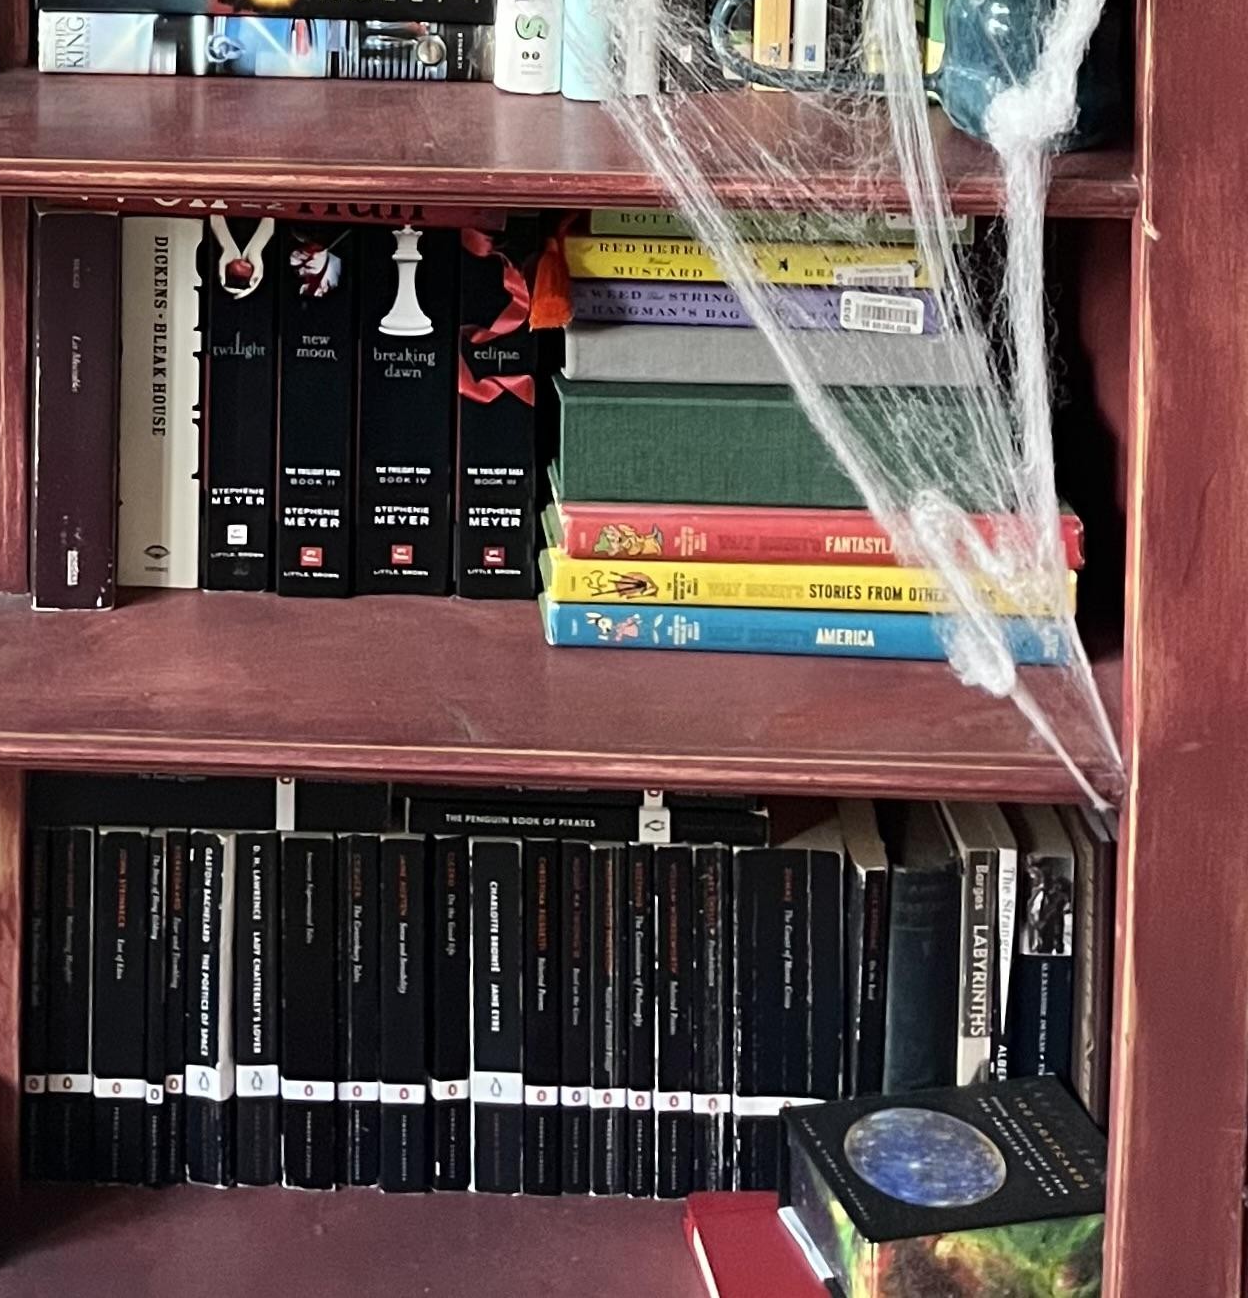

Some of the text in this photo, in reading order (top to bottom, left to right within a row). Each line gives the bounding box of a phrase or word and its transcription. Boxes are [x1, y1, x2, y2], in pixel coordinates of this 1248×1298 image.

[152, 237, 168, 436] DICKENS BLEAK HOUSE
[212, 331, 266, 359] twilight
[302, 334, 331, 347] new
[296, 346, 338, 360] moon
[373, 348, 436, 366] breaking
[384, 364, 422, 378] dawn
[284, 515, 340, 528] MEYER
[810, 583, 902, 601] STORIES FROM
[816, 627, 874, 648] AMERICA
[446, 814, 596, 828] THE PENGUIN BOOK OF PIRATES
[970, 925, 989, 1037] LABYRINTHS
